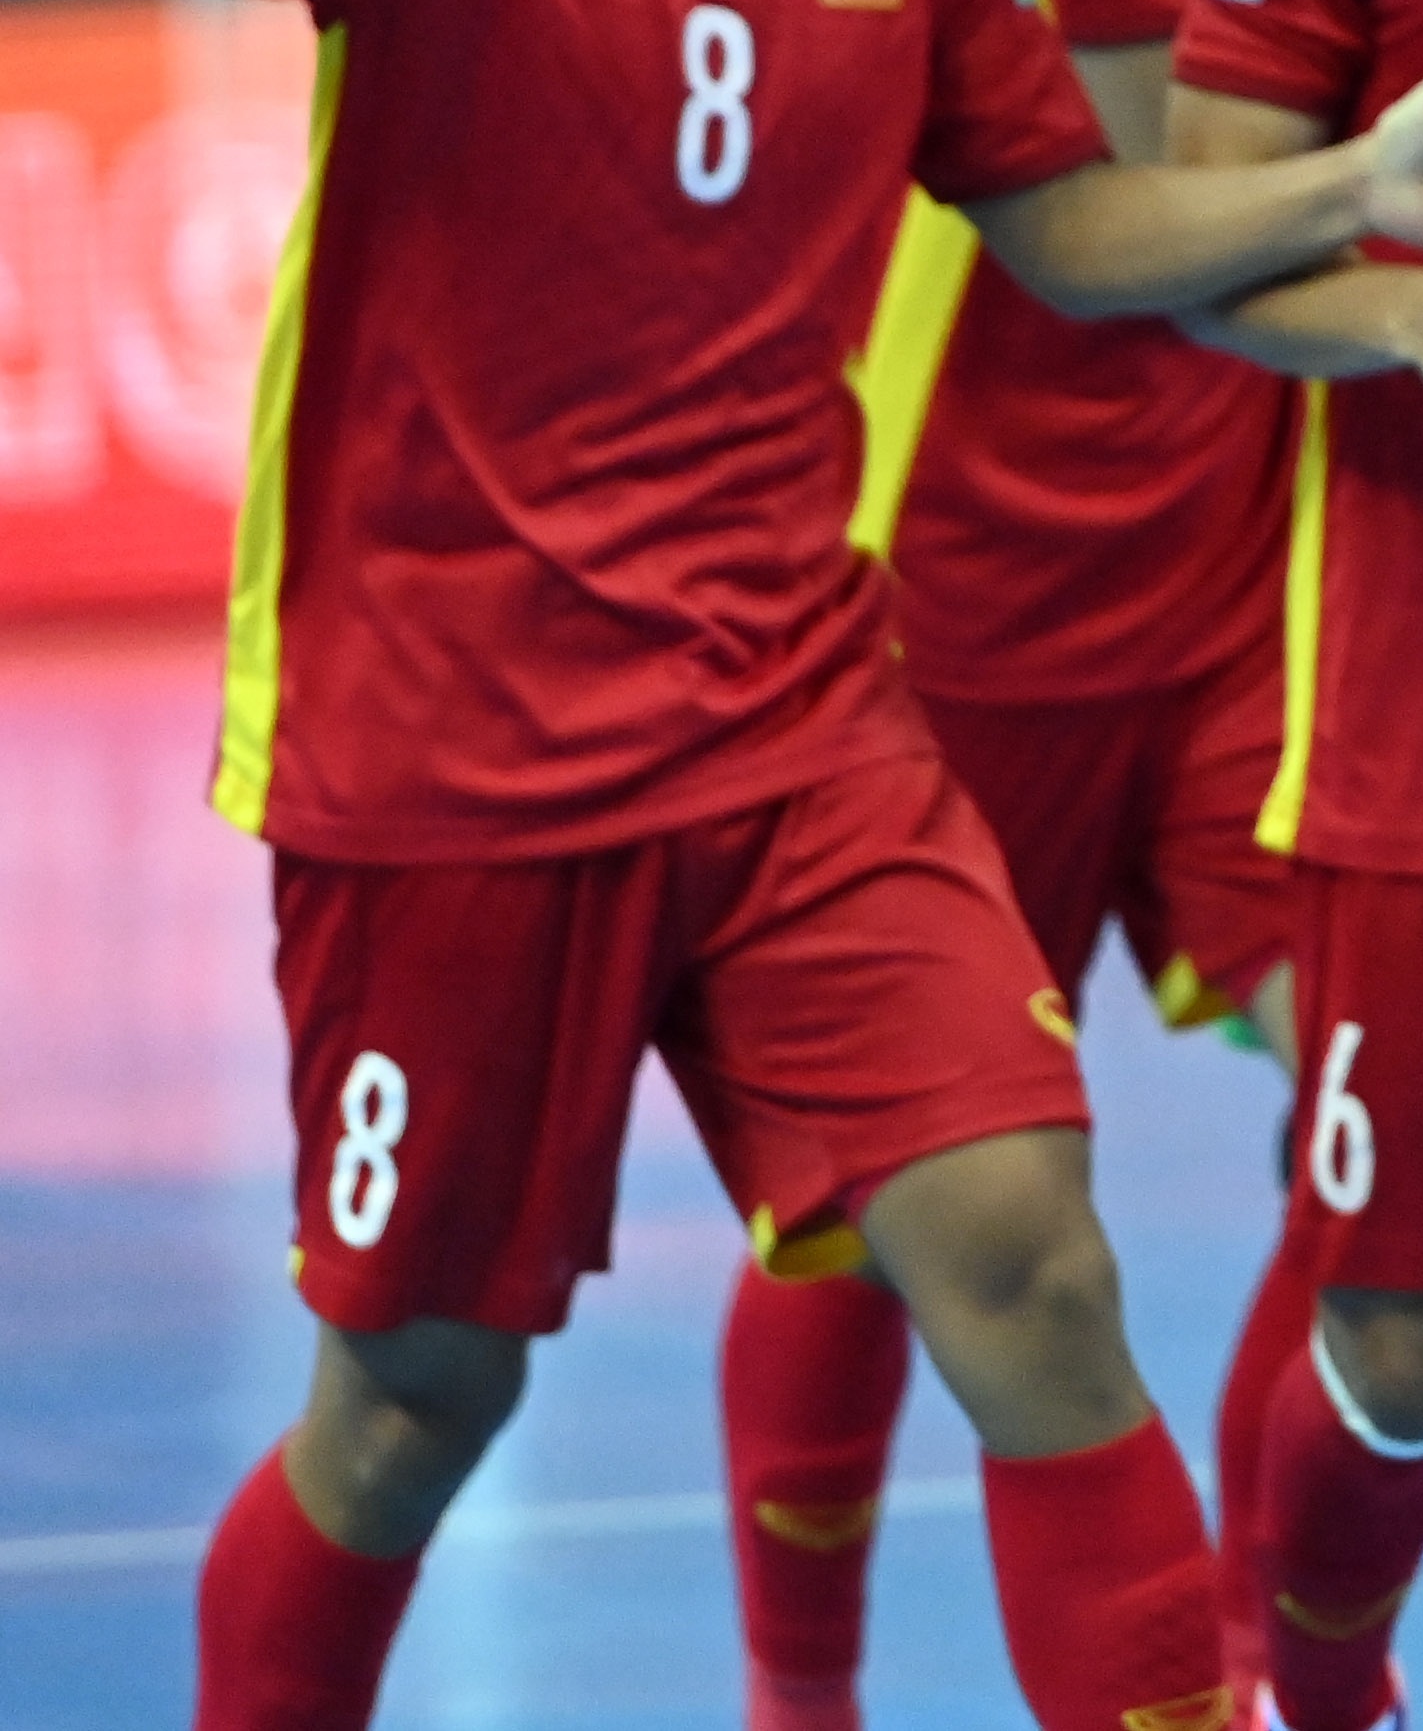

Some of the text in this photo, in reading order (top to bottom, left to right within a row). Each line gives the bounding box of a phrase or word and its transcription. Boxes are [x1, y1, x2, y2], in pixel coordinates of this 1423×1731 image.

[676, 4, 755, 203] 8
[328, 1050, 409, 1250] 8
[1309, 1021, 1375, 1215] 6
